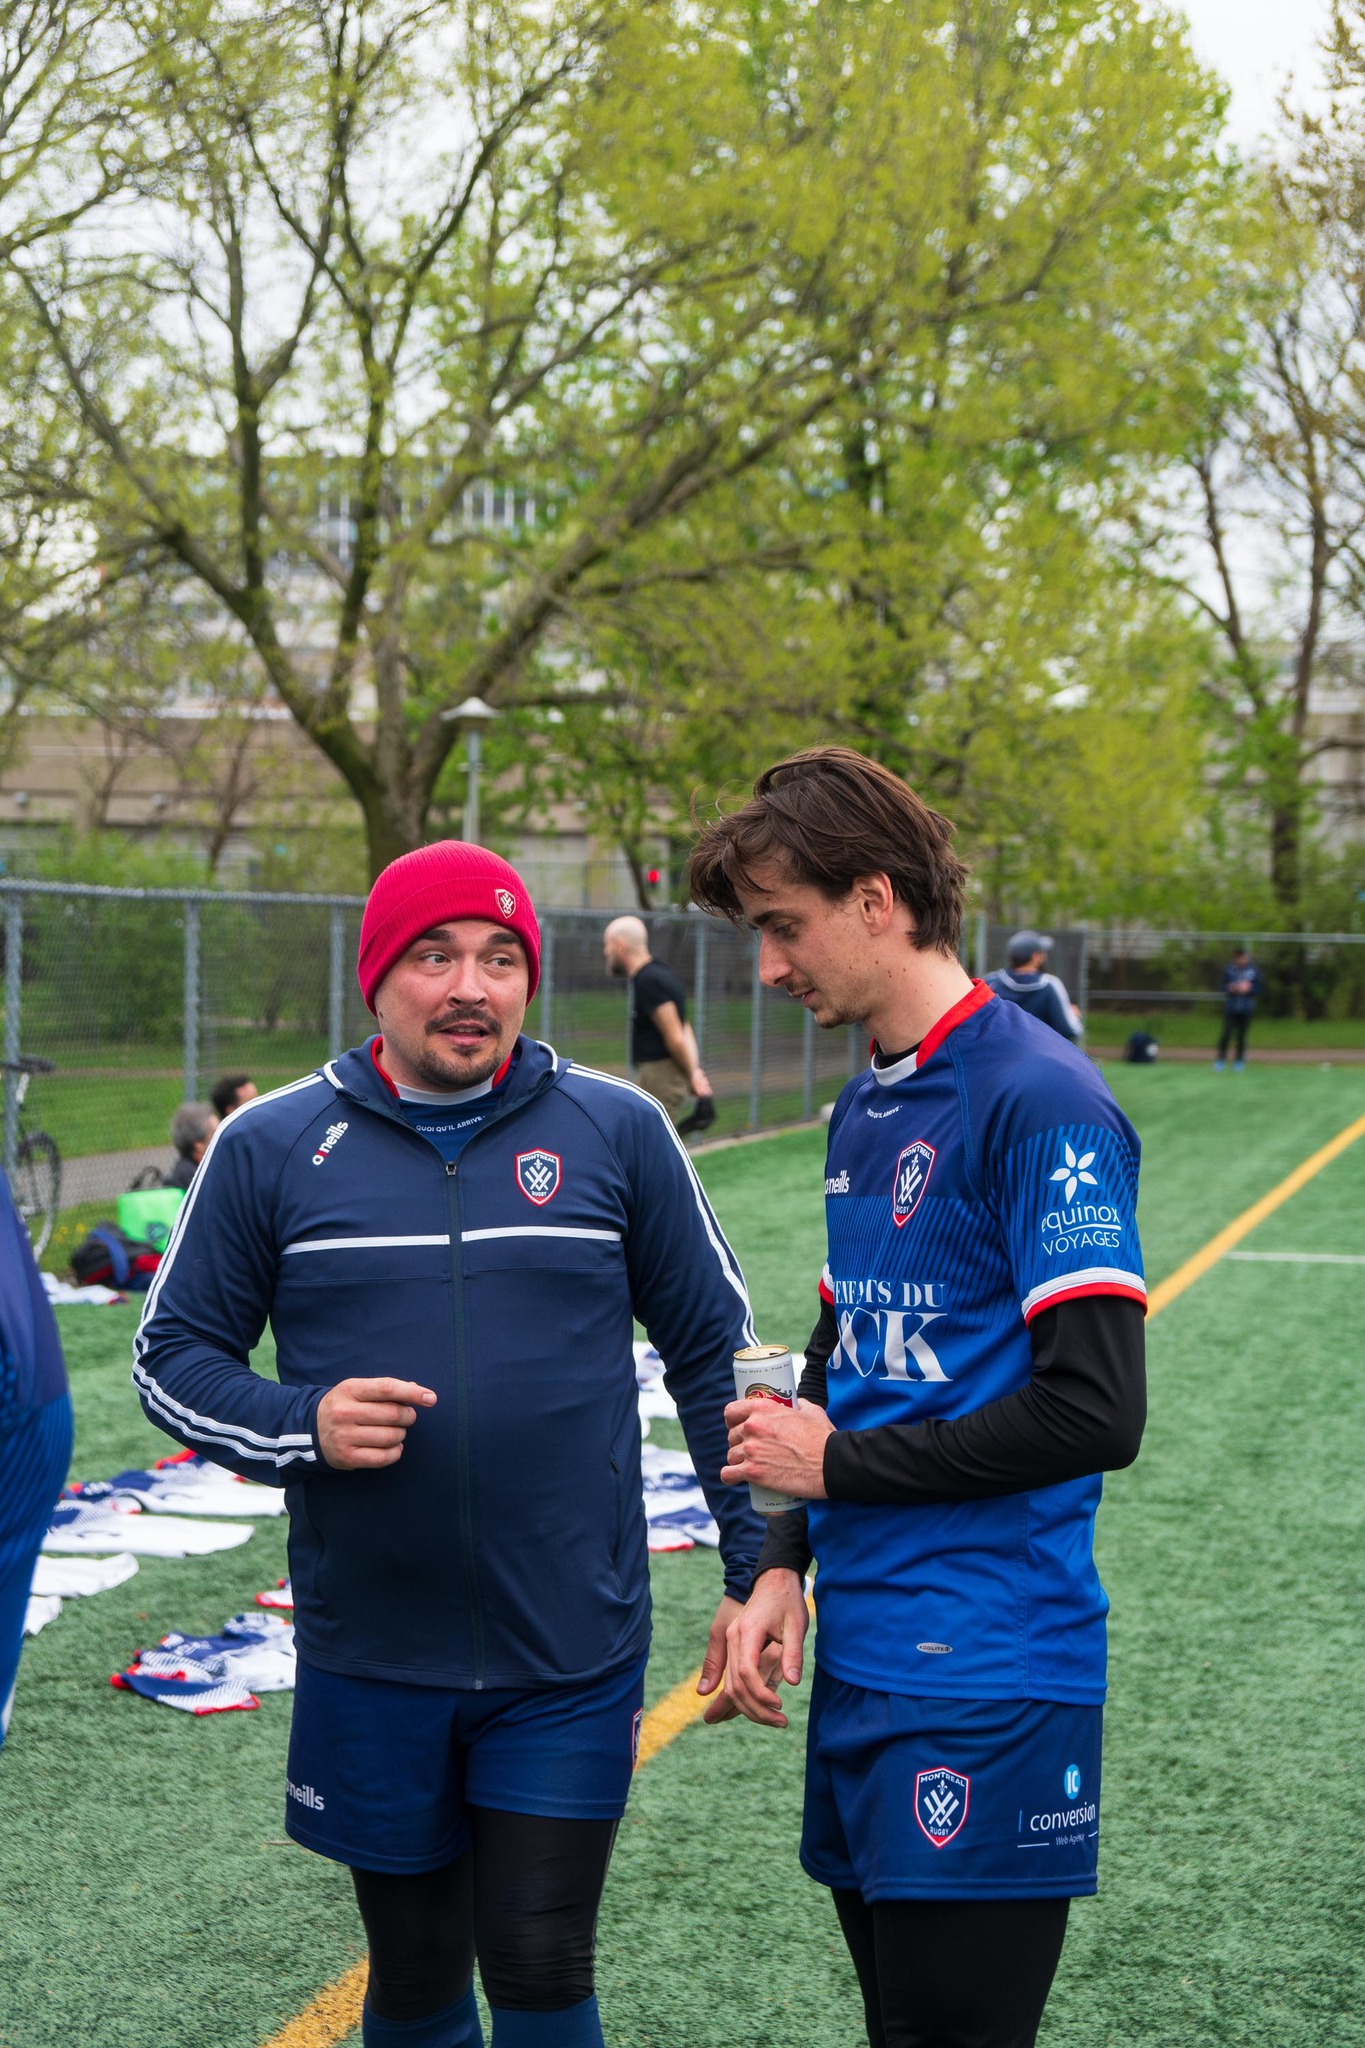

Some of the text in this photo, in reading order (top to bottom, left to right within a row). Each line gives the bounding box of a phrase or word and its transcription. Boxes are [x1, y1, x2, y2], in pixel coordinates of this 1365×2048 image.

[416, 1115, 484, 1132] QUOI QU'IL ARRIVE
[520, 1153, 556, 1164] MONTREAL
[901, 1145, 931, 1160] MONTREAL
[896, 1204, 910, 1214] RUGBY
[1041, 1201, 1121, 1234] equinox
[1042, 1230, 1120, 1256] VOYAGES
[902, 1282, 946, 1308] DU
[920, 1771, 965, 1787] MONTREAL
[1067, 1770, 1079, 1794] IC
[287, 1779, 325, 1811] neills
[1030, 1801, 1096, 1831] conversion
[929, 1826, 950, 1836] RUGBY
